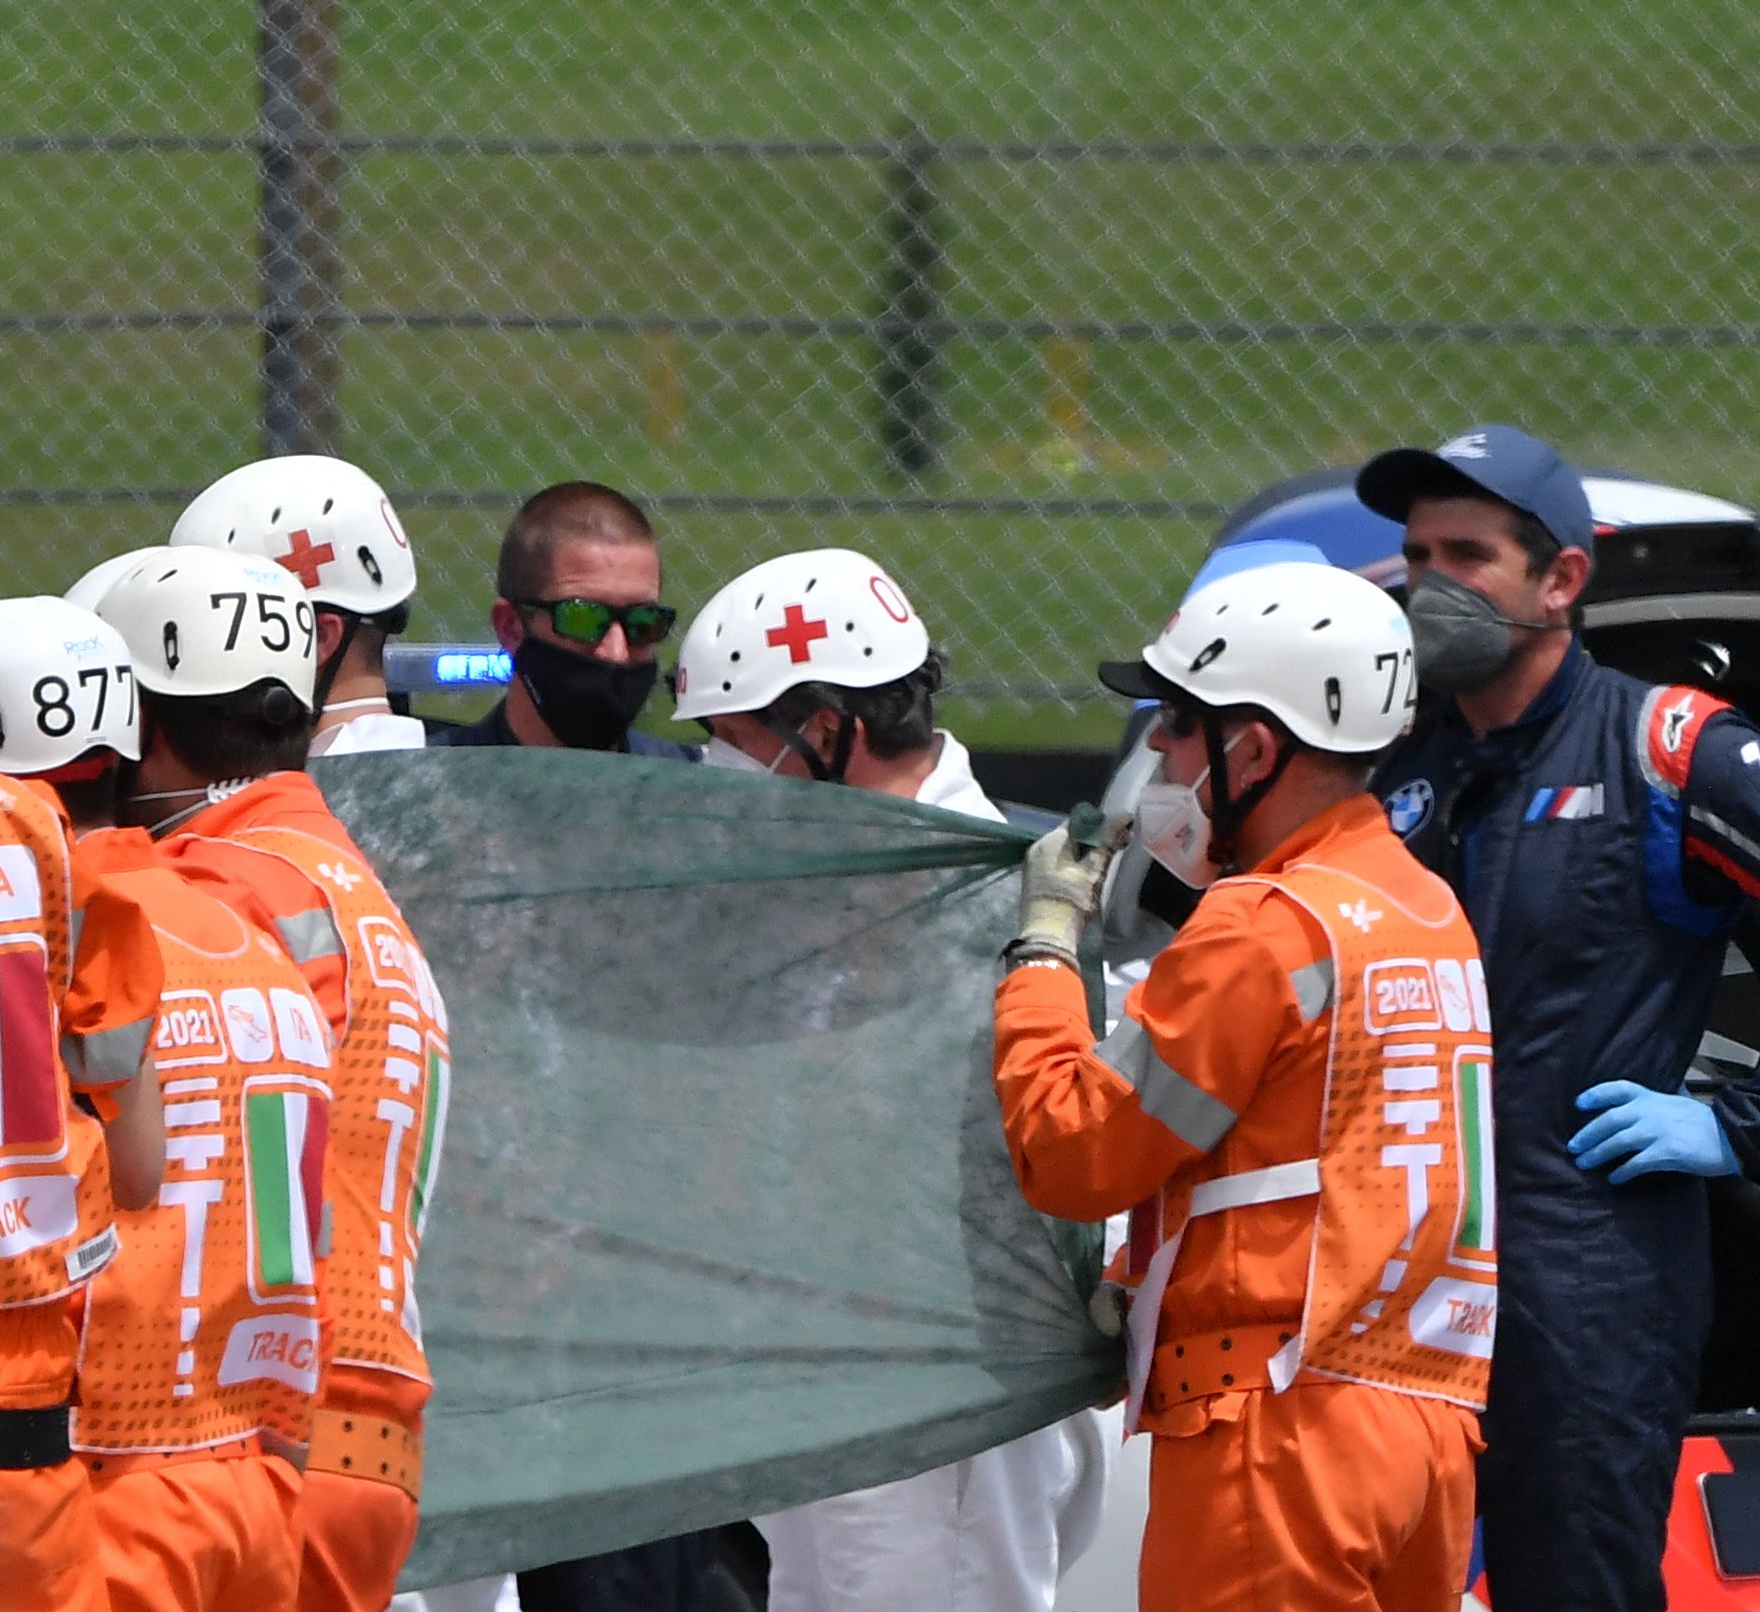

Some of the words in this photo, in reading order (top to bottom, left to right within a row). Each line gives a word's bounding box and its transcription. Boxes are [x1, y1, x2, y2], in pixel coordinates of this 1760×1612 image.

[210, 591, 315, 659] 759
[1375, 976, 1433, 1015] 2021
[157, 1008, 215, 1049] 2021
[247, 1331, 315, 1373] TRAC
